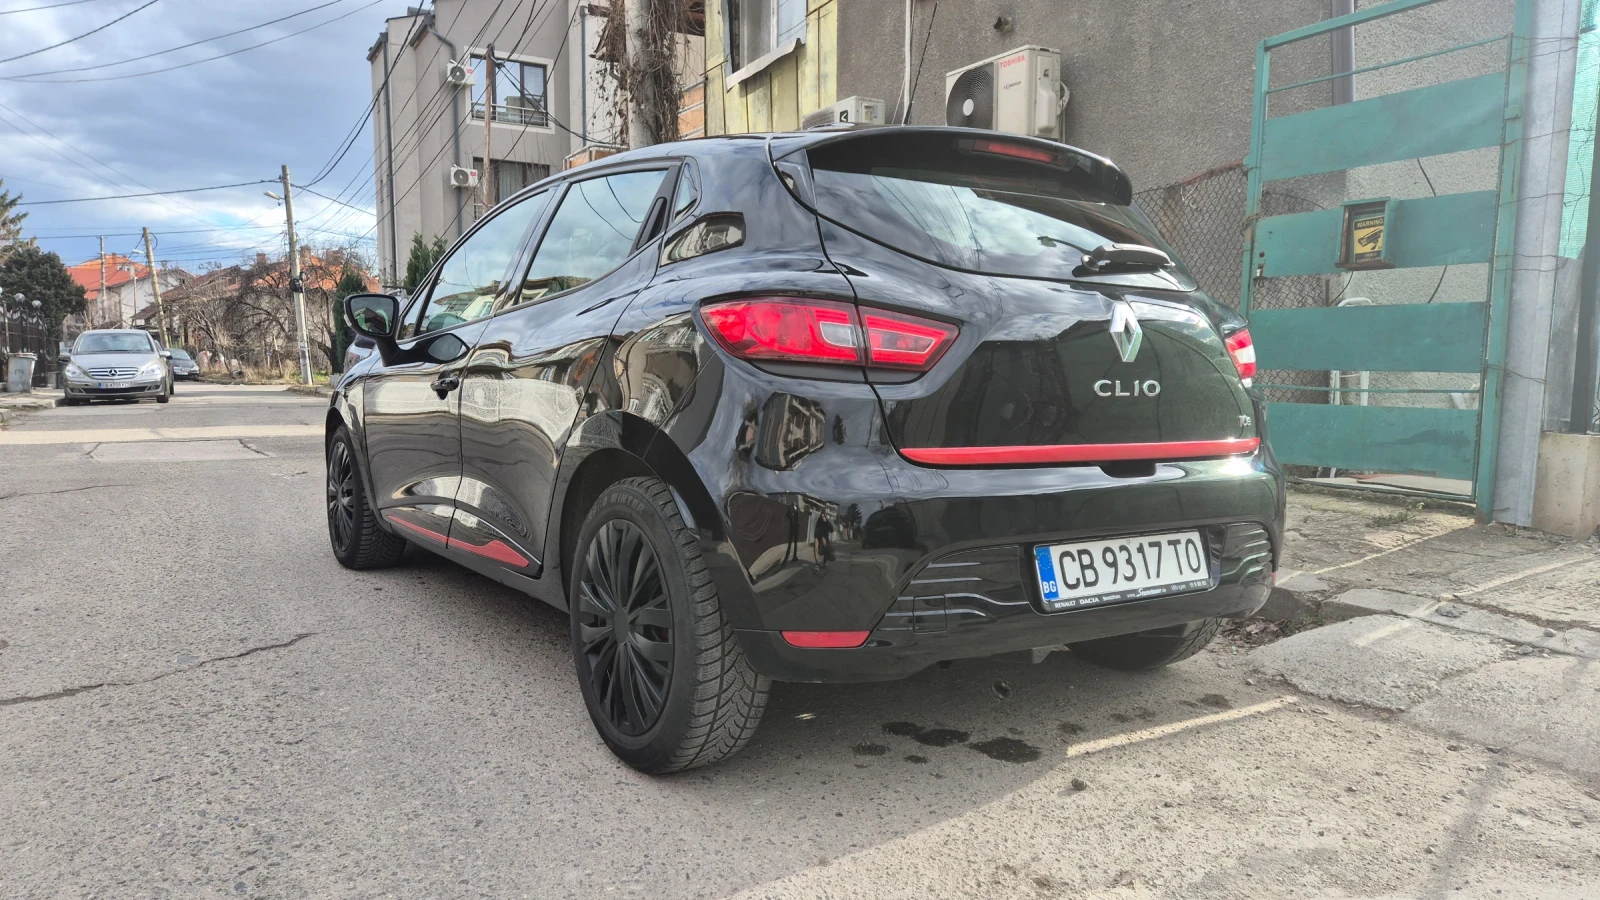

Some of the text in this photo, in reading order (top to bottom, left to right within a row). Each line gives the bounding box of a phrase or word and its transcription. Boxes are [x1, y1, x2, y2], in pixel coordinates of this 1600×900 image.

[1000, 55, 1025, 68] TOSHIBA
[1357, 219, 1383, 228] WARNING
[1094, 379, 1161, 397] CLIO
[610, 492, 645, 515] WINTER
[1059, 538, 1201, 590] CB 9317 TO
[1042, 580, 1057, 594] BG
[1054, 600, 1076, 609] RENAULT
[1079, 597, 1099, 605] DACIA
